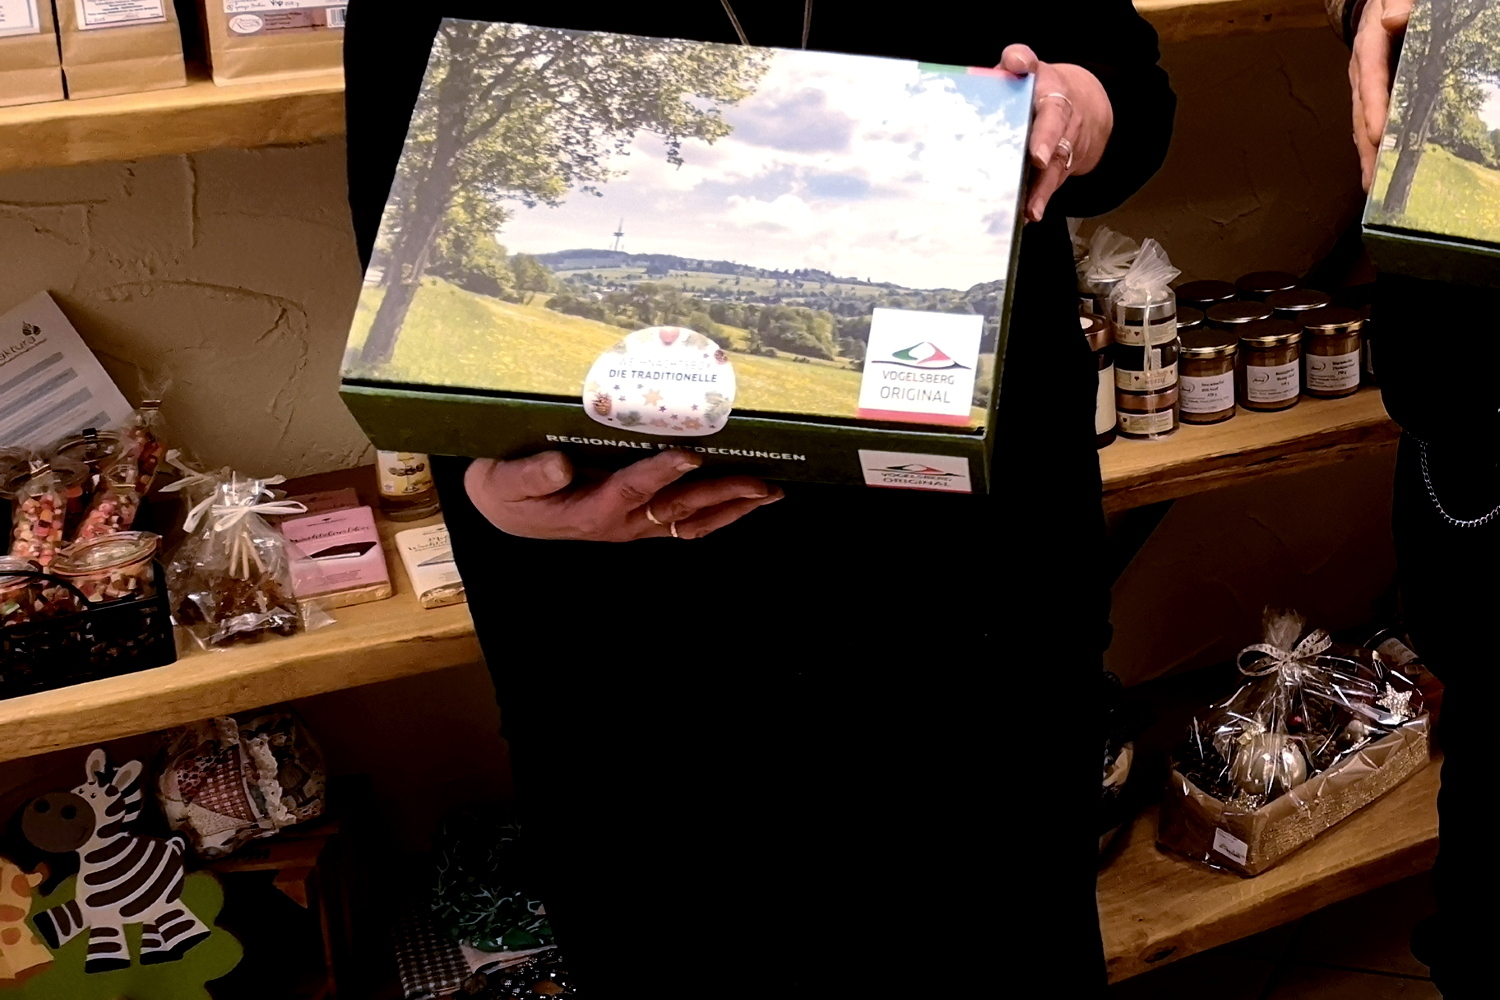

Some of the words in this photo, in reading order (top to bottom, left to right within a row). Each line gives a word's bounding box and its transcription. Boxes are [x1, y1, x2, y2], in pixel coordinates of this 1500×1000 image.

[608, 369, 628, 379] DIE
[631, 370, 718, 384] TRADITIONELLE
[882, 369, 955, 385] VOGELSBERG
[880, 386, 951, 404] ORIGINAL
[545, 434, 652, 450] REGIONALE
[882, 477, 951, 487] ORIGINAL
